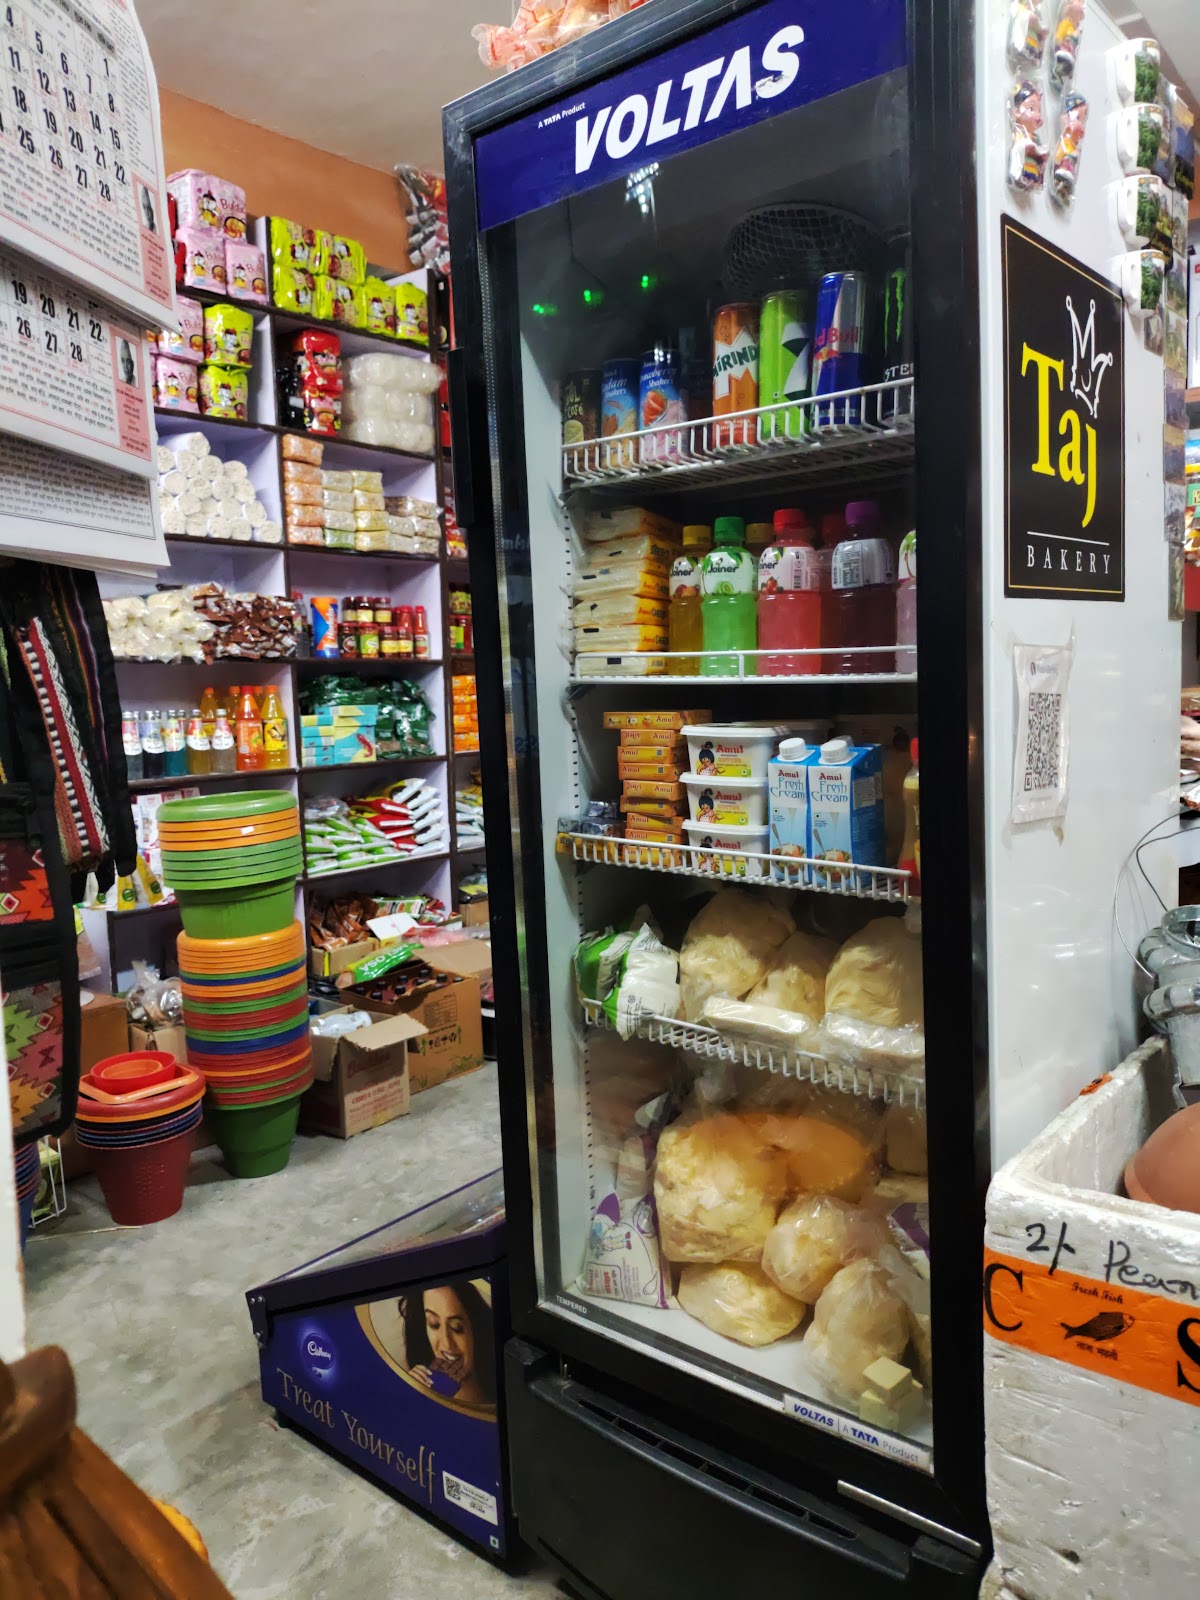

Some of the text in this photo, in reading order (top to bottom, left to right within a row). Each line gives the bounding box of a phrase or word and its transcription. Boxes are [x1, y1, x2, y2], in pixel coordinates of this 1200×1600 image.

[6, 5, 14, 28] 4
[34, 30, 44, 54] 5
[60, 52, 68, 75] 6
[108, 92, 114, 113] 8
[103, 58, 110, 78] 1
[8, 46, 21, 73] 11
[36, 68, 50, 95] 12
[62, 86, 76, 113] 13
[90, 110, 102, 135] 14
[110, 126, 121, 150] 15
[575, 24, 805, 175] VOLTAS
[544, 114, 561, 126] TATA
[562, 102, 586, 118] Product
[12, 85, 126, 186] 18 19 20 21 22
[18, 124, 111, 202] 25 26 27 28
[11, 280, 102, 342] 19 20 21 22
[16, 316, 82, 363] 26 27 28
[1021, 342, 1098, 528] Taj
[708, 562, 738, 574] Joiner
[1026, 544, 1112, 575] BAKERY
[716, 744, 744, 753] Amul
[778, 770, 799, 778] Amul
[778, 778, 804, 790] Fresh
[819, 772, 842, 781] Amul
[715, 791, 742, 801] Amul
[770, 786, 805, 799] Cream
[811, 791, 848, 802] Cream
[820, 781, 847, 794] Fresh
[631, 815, 649, 823] Amul
[715, 839, 741, 849] Amul
[556, 1294, 587, 1314] TEMPERED
[984, 1262, 1023, 1332] C
[1072, 1282, 1124, 1304] Fresh Fish
[276, 1368, 436, 1504] Treat Yourself
[794, 1404, 919, 1462] VOLTAS A TATA Product
